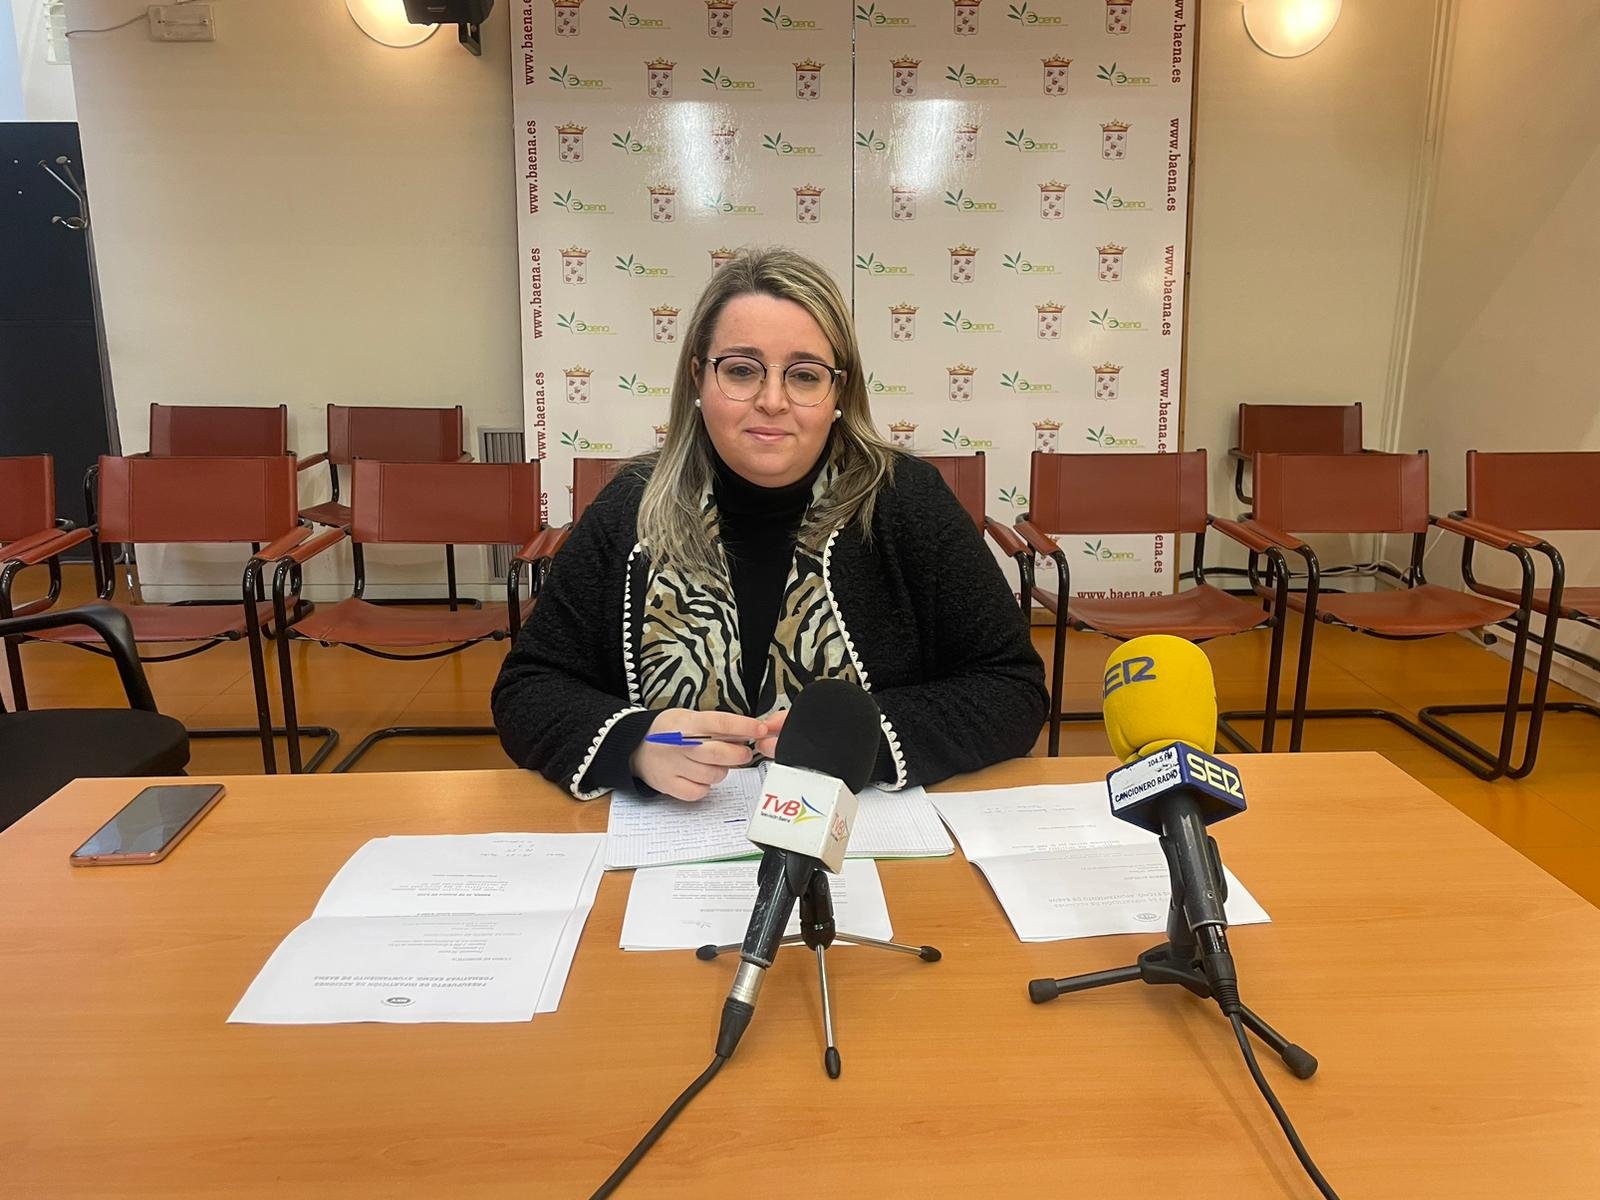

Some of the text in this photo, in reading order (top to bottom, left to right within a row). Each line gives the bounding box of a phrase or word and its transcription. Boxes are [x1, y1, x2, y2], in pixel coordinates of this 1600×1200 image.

[521, 0, 535, 85] www.baena.e
[1170, 0, 1184, 84] ww.baena.es
[526, 120, 537, 214] www.baena.es
[1167, 118, 1179, 212] www.baena.es
[529, 248, 542, 339] www.baena.es
[1162, 246, 1175, 336] www.baena.es
[534, 372, 546, 459] www.baena.es
[1115, 769, 1178, 803] CANCIONERO RADIO
